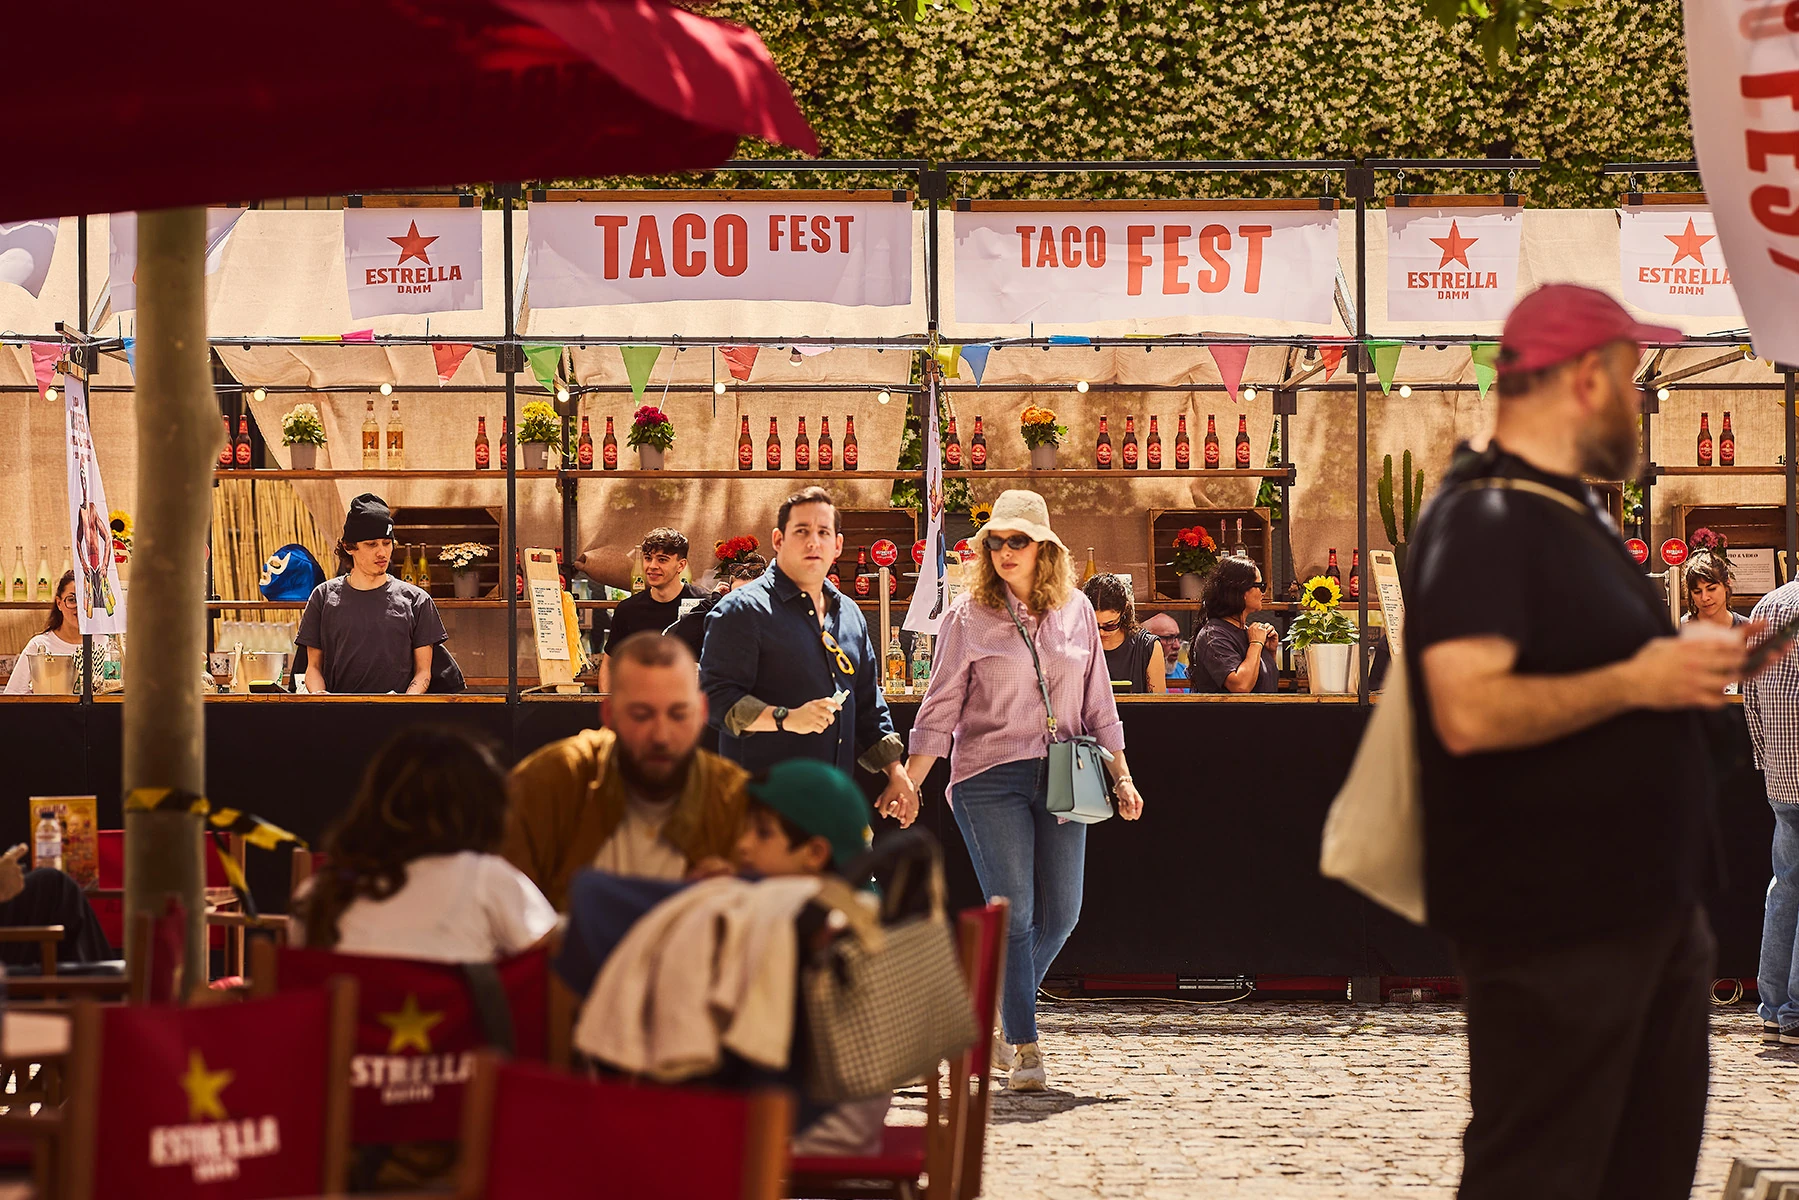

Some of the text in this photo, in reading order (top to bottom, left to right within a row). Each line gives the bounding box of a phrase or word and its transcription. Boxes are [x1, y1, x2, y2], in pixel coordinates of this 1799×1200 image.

[594, 213, 854, 279] TACO FEST
[1015, 223, 1273, 297] TACO FEST
[365, 266, 462, 285] ESTRELLA
[1407, 271, 1498, 289] ESTRELLA
[397, 285, 432, 294] DAMM
[1437, 290, 1470, 300] DAMM
[1669, 285, 1705, 295] DAMM
